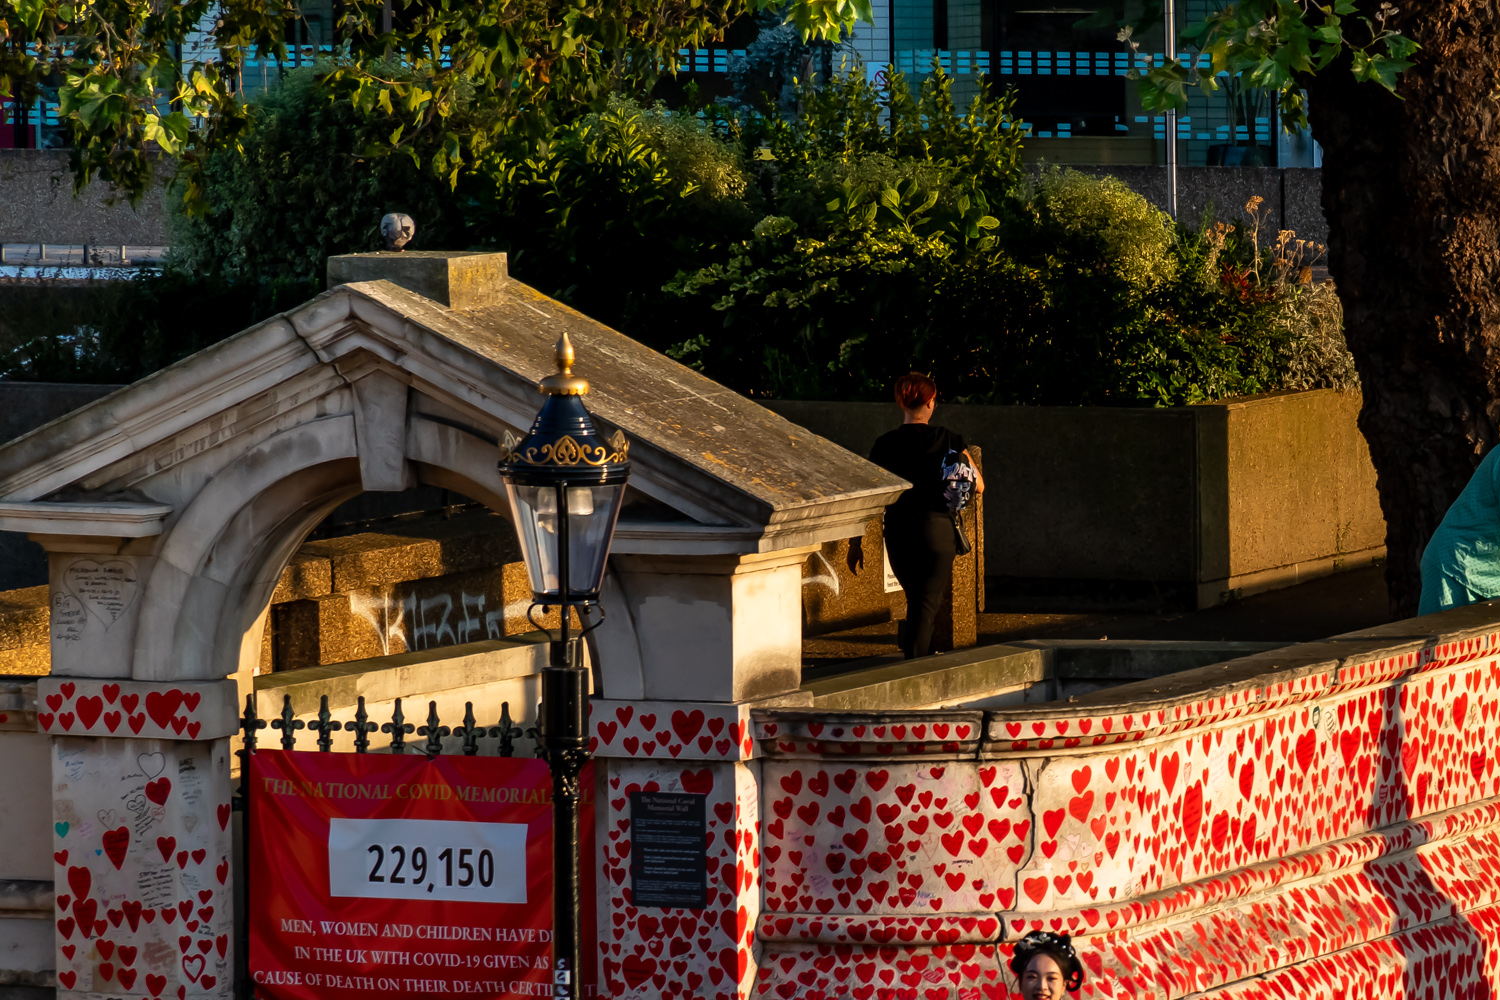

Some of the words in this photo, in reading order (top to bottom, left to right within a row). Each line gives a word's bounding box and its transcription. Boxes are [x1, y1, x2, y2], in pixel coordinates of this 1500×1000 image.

[262, 777, 297, 796] THE
[301, 780, 392, 800] NATIONAL
[396, 784, 452, 800] COVID
[455, 785, 552, 804] MEMORIAL
[366, 844, 495, 893] 229,150
[281, 918, 316, 936] MEN,
[320, 921, 378, 936] WOMEN
[381, 924, 413, 938] AND
[416, 925, 492, 941] CHILDREN
[496, 928, 536, 942] HAVE
[540, 930, 554, 943] DI
[294, 946, 310, 960] IN
[313, 947, 342, 962] THE
[346, 949, 368, 963] UK
[370, 950, 410, 965] WITH
[413, 952, 480, 968] COVID-19
[483, 955, 530, 969] GIVEN
[533, 956, 549, 970] AS
[253, 971, 303, 985] CAUSE
[305, 973, 323, 986] OF
[326, 974, 374, 990] DEATH
[378, 978, 400, 991] ON
[403, 979, 450, 993] THEIR
[453, 980, 506, 994] DEATH
